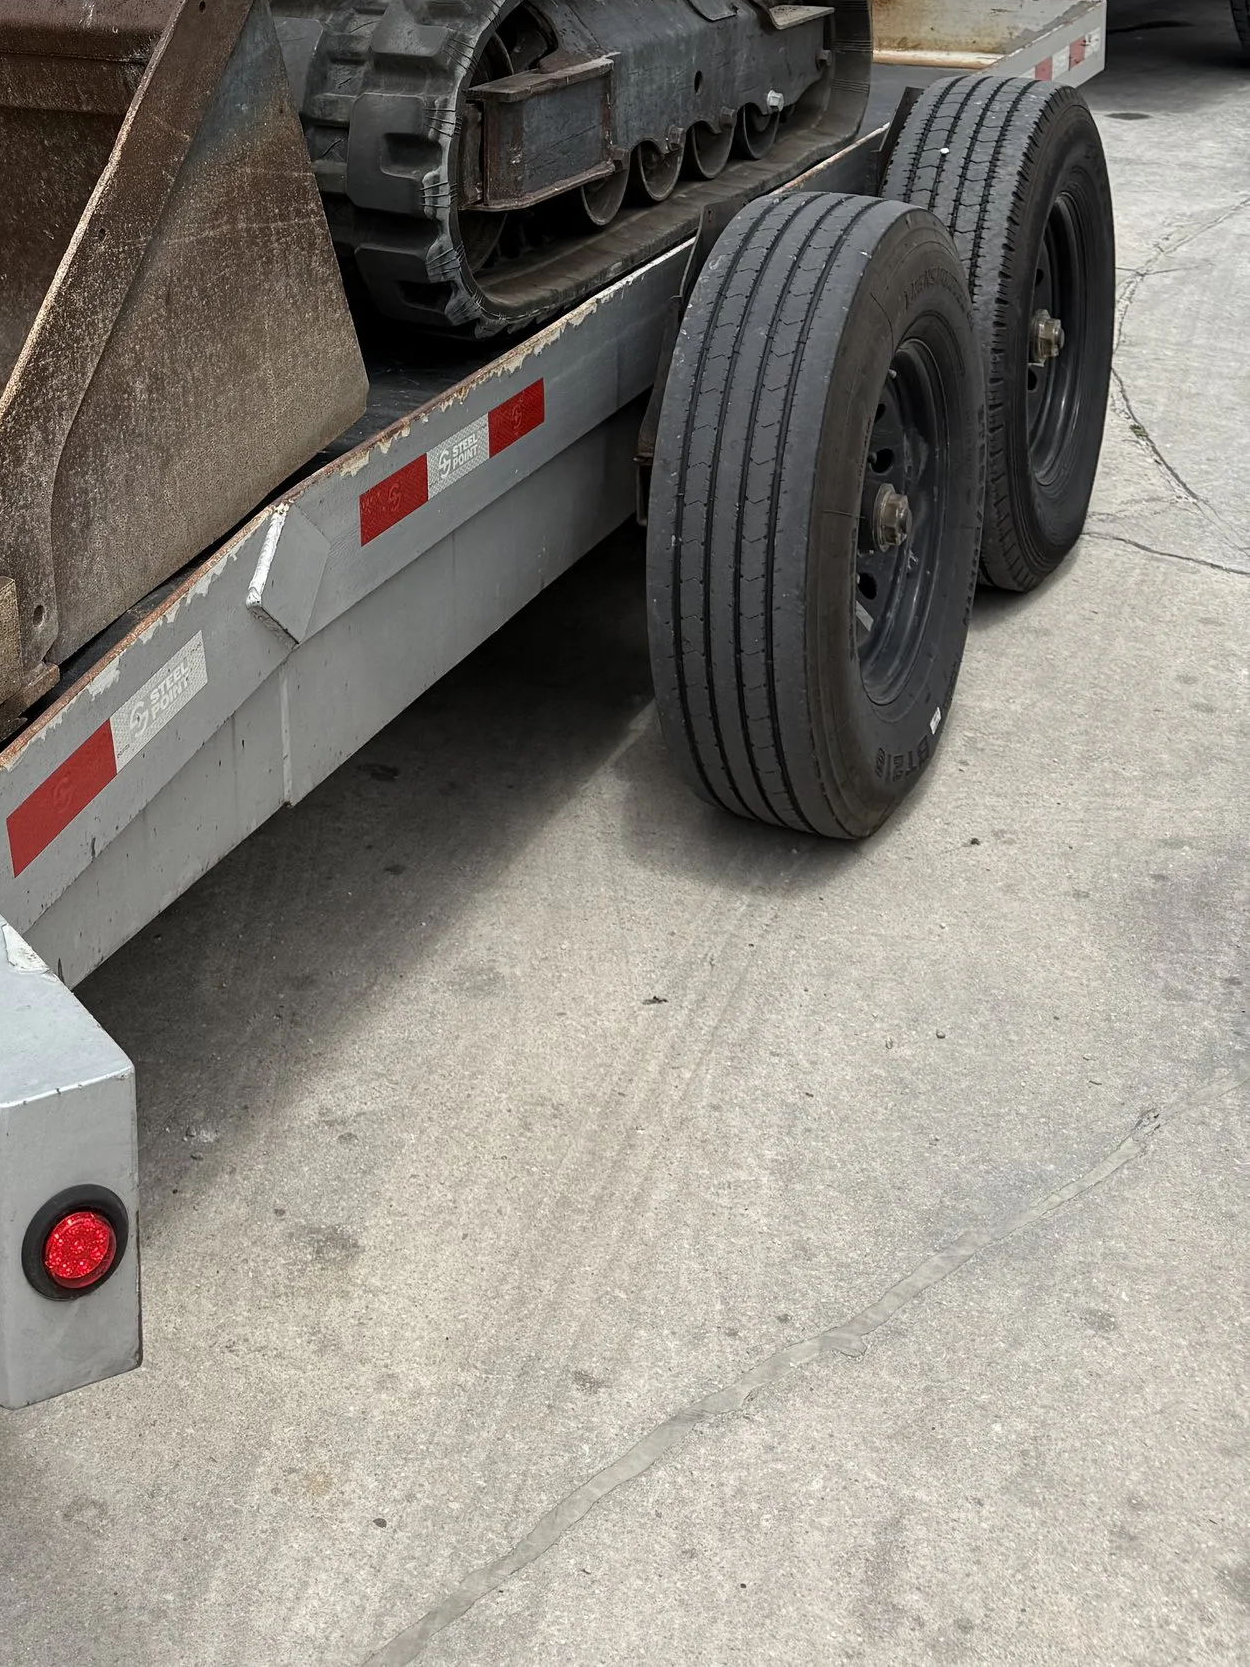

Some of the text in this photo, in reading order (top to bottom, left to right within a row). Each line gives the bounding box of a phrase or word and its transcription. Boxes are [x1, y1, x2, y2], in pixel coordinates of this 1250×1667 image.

[452, 433, 479, 458] STEEL
[452, 444, 479, 470] POINT
[150, 656, 191, 705] STEEL
[151, 676, 190, 720] POINT
